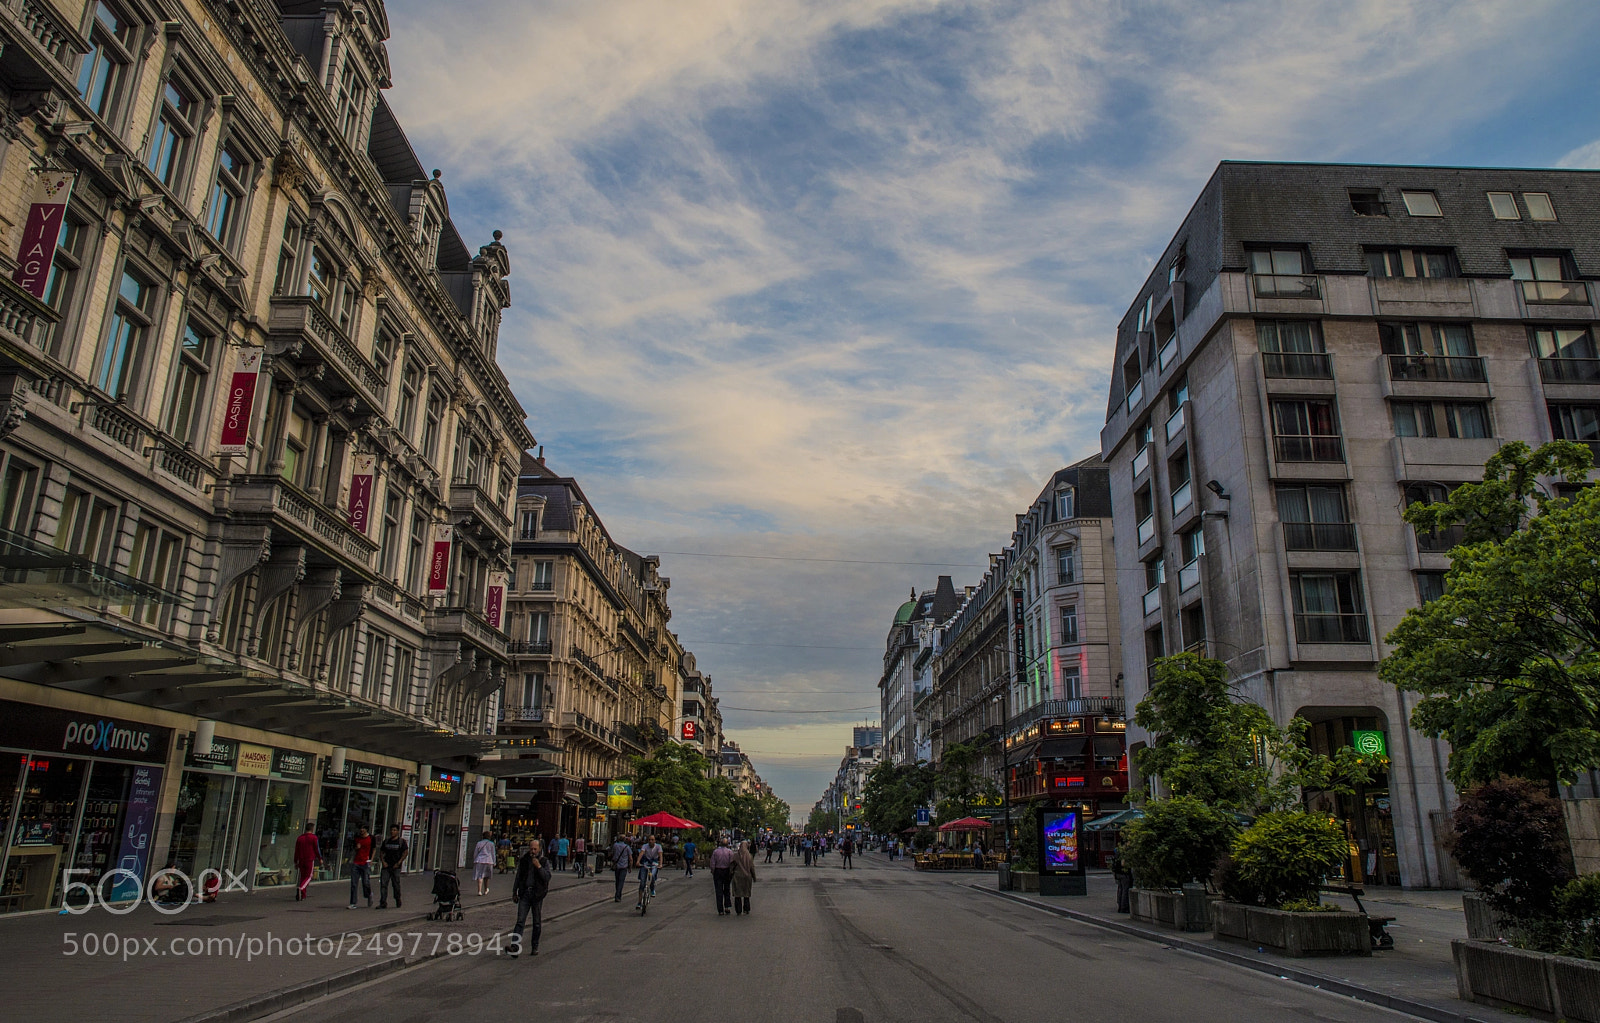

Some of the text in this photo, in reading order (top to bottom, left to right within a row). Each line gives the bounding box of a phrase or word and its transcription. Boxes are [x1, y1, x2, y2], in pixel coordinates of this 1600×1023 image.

[21, 207, 56, 293] VIAGE
[228, 387, 244, 429] CASINO
[352, 476, 368, 530] VIAGE
[433, 551, 443, 580] CASINO
[489, 587, 500, 627] VIAGE
[685, 722, 694, 732] Q
[244, 752, 267, 762] MAISONS
[1061, 831, 1074, 839] play
